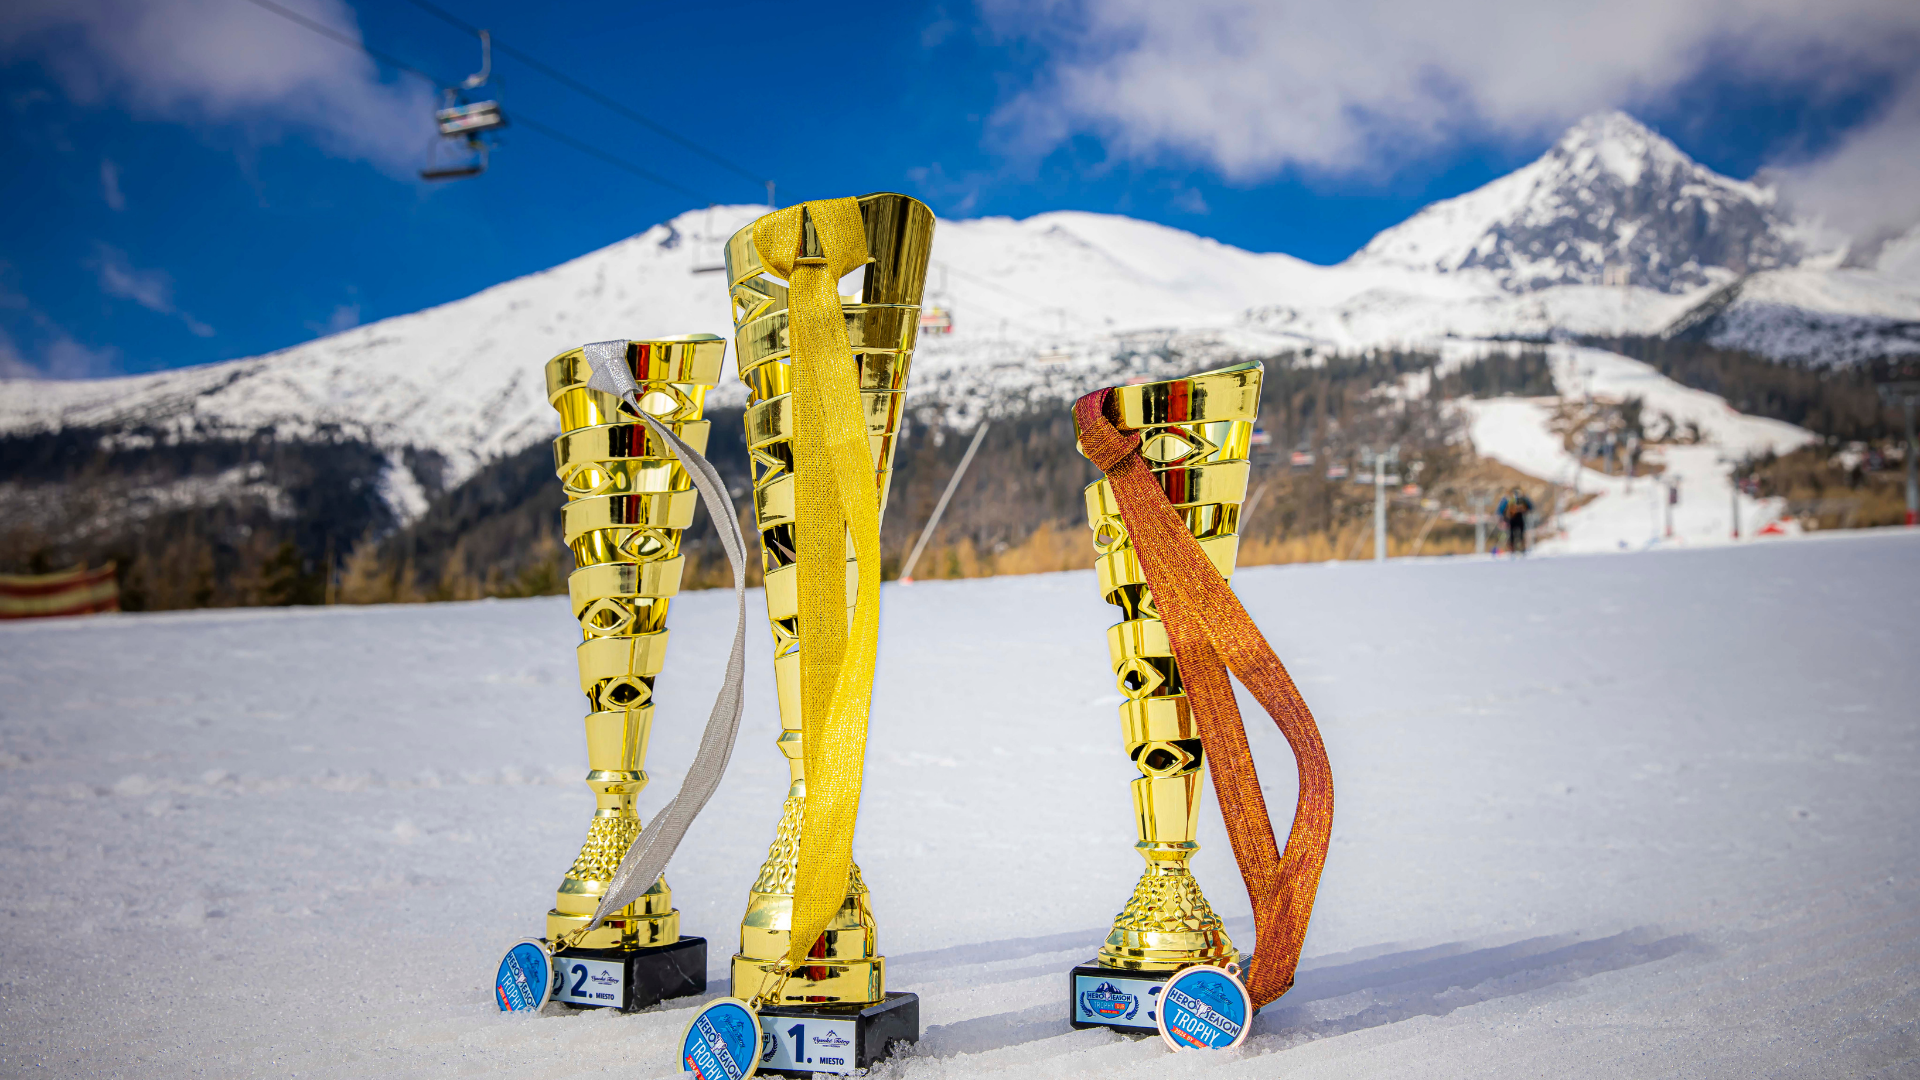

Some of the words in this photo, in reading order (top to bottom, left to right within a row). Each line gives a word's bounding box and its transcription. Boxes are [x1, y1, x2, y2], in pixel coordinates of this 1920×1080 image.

[571, 964, 593, 998] 2.
[596, 992, 615, 1000] MIESTO
[697, 1016, 716, 1043] HERO
[1169, 989, 1197, 1010] HERO
[1205, 1010, 1239, 1036] SEASON
[1172, 1008, 1220, 1046] TROPHY
[787, 1023, 813, 1064] 1.
[819, 1056, 845, 1066] MIESTO
